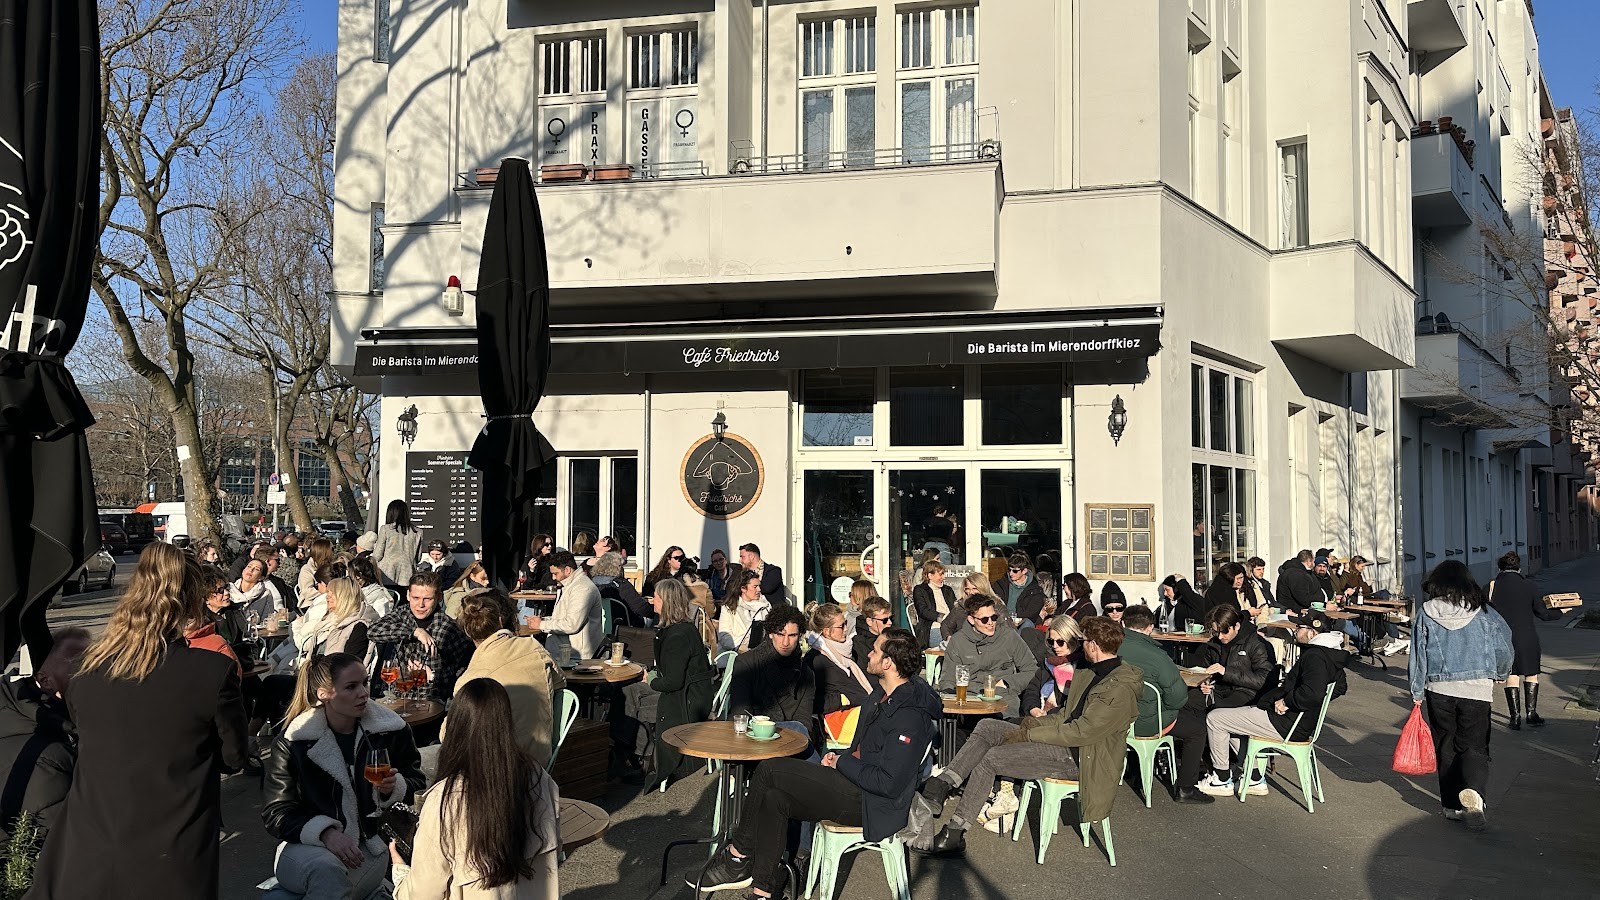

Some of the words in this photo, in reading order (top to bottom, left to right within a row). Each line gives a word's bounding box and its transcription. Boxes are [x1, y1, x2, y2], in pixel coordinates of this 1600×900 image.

[967, 343, 985, 354] Die
[988, 341, 1029, 354] Barista
[1031, 341, 1046, 353] im
[1048, 337, 1141, 352] Mierendorffkiez
[372, 355, 387, 367] Die
[388, 355, 422, 366] Barista
[424, 355, 436, 366] im
[683, 346, 712, 368] Café
[714, 346, 780, 363] Friedrichs
[700, 491, 743, 503] Friedrichs
